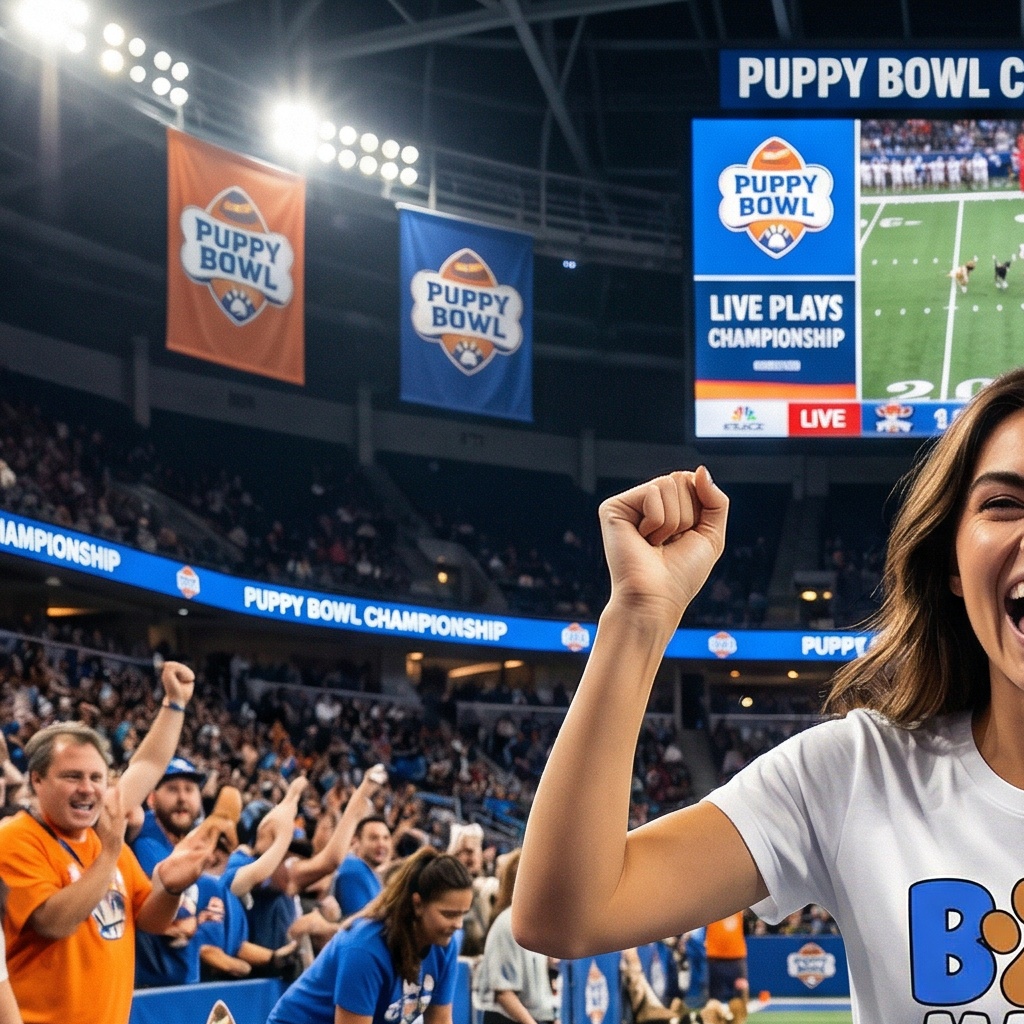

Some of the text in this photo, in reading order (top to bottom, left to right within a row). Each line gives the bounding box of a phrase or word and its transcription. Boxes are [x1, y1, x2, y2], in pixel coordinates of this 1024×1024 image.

[739, 57, 867, 98] PUPPY
[878, 57, 989, 98] BOWL
[734, 174, 817, 194] PUPPY
[739, 196, 815, 217] BOWL
[195, 217, 281, 264] PUPPY
[200, 245, 278, 291] BOWL
[427, 281, 509, 315] PUPPY
[710, 294, 844, 321] LIVE PLAYS
[432, 306, 506, 339] BOWL
[708, 327, 845, 349] CHAMPIONSHIP
[800, 408, 846, 428] LIVE
[244, 586, 508, 641] PUPPY BOWL CHAMPIONSHIP
[801, 635, 868, 658] PUPPY
